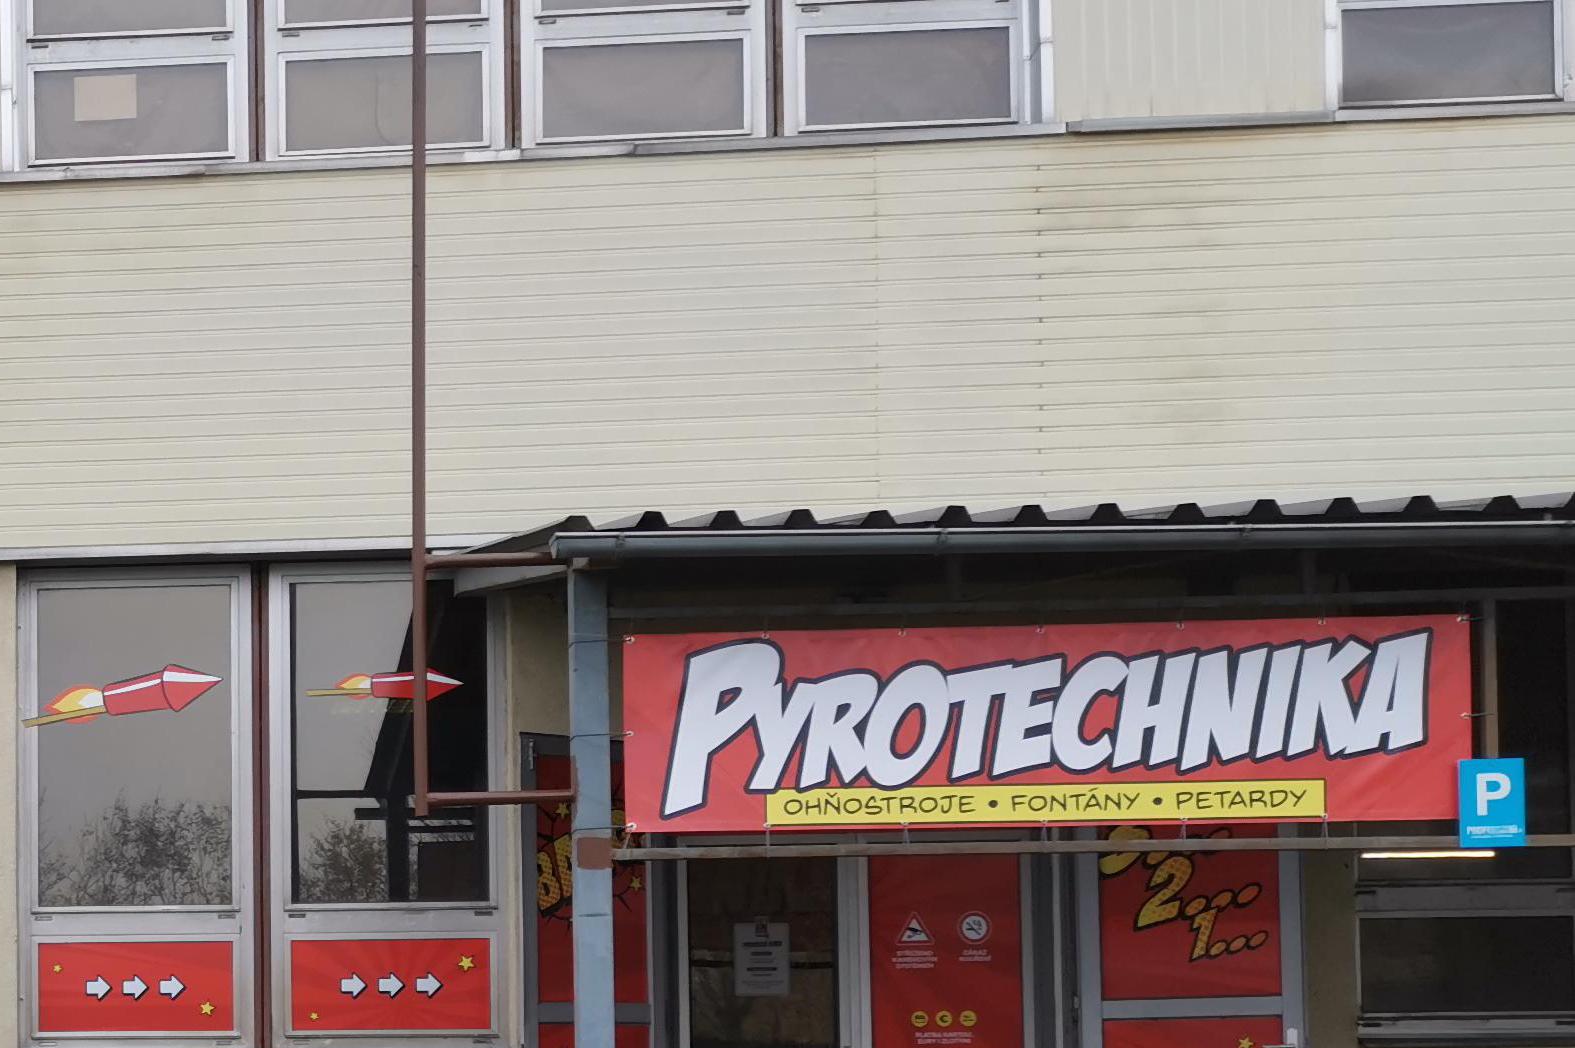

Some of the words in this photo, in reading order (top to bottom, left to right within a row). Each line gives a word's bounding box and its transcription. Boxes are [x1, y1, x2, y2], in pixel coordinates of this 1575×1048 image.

[662, 630, 1430, 818] PYROTECHNIKA
[784, 793, 976, 816] OHŇOSTROJE
[1011, 788, 1141, 812] FONTÁNY
[1176, 790, 1306, 811] PETARDY
[1476, 772, 1512, 816] P
